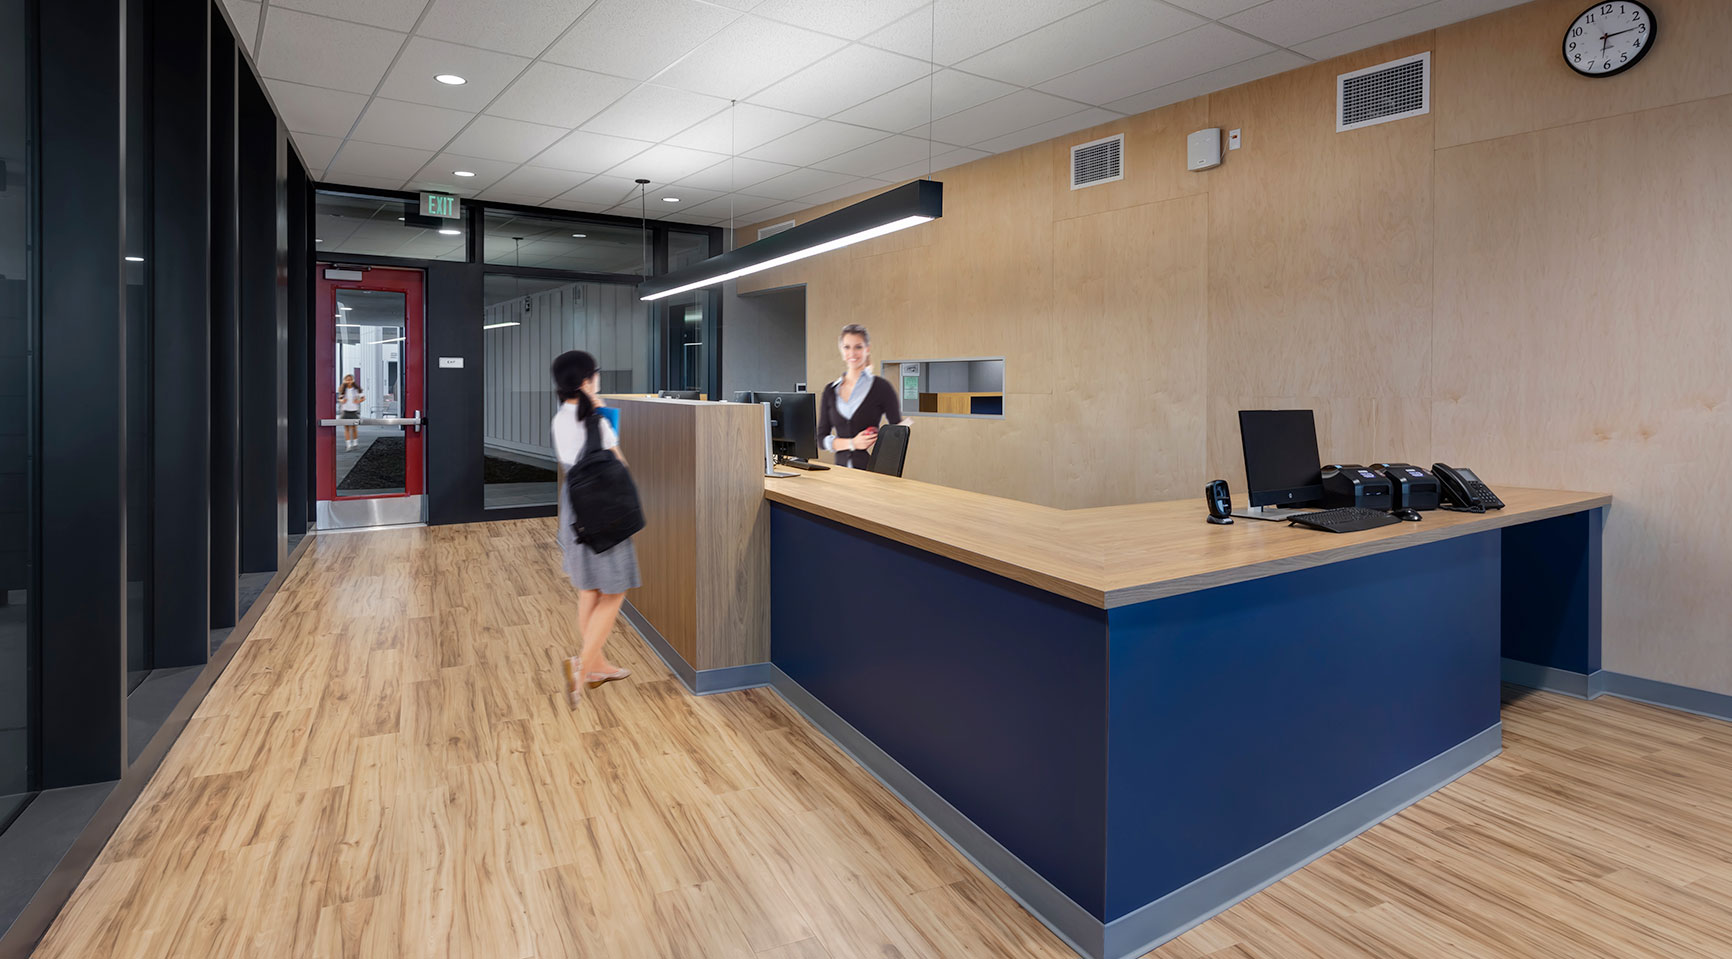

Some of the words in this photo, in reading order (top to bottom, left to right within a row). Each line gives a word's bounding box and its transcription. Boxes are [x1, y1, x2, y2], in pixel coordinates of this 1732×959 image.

[1600, 4, 1613, 16] 12
[1620, 5, 1625, 14] 1
[1586, 14, 1595, 24] 11
[1632, 11, 1640, 21] 2
[1572, 27, 1583, 38] 10
[1638, 23, 1646, 34] 3
[1569, 42, 1577, 52] 9
[1632, 38, 1641, 48] 4
[1574, 53, 1582, 63] 8
[1620, 52, 1628, 63] 5
[1587, 60, 1595, 71] 7
[1603, 60, 1611, 70] 6
[428, 195, 455, 216] EXIT
